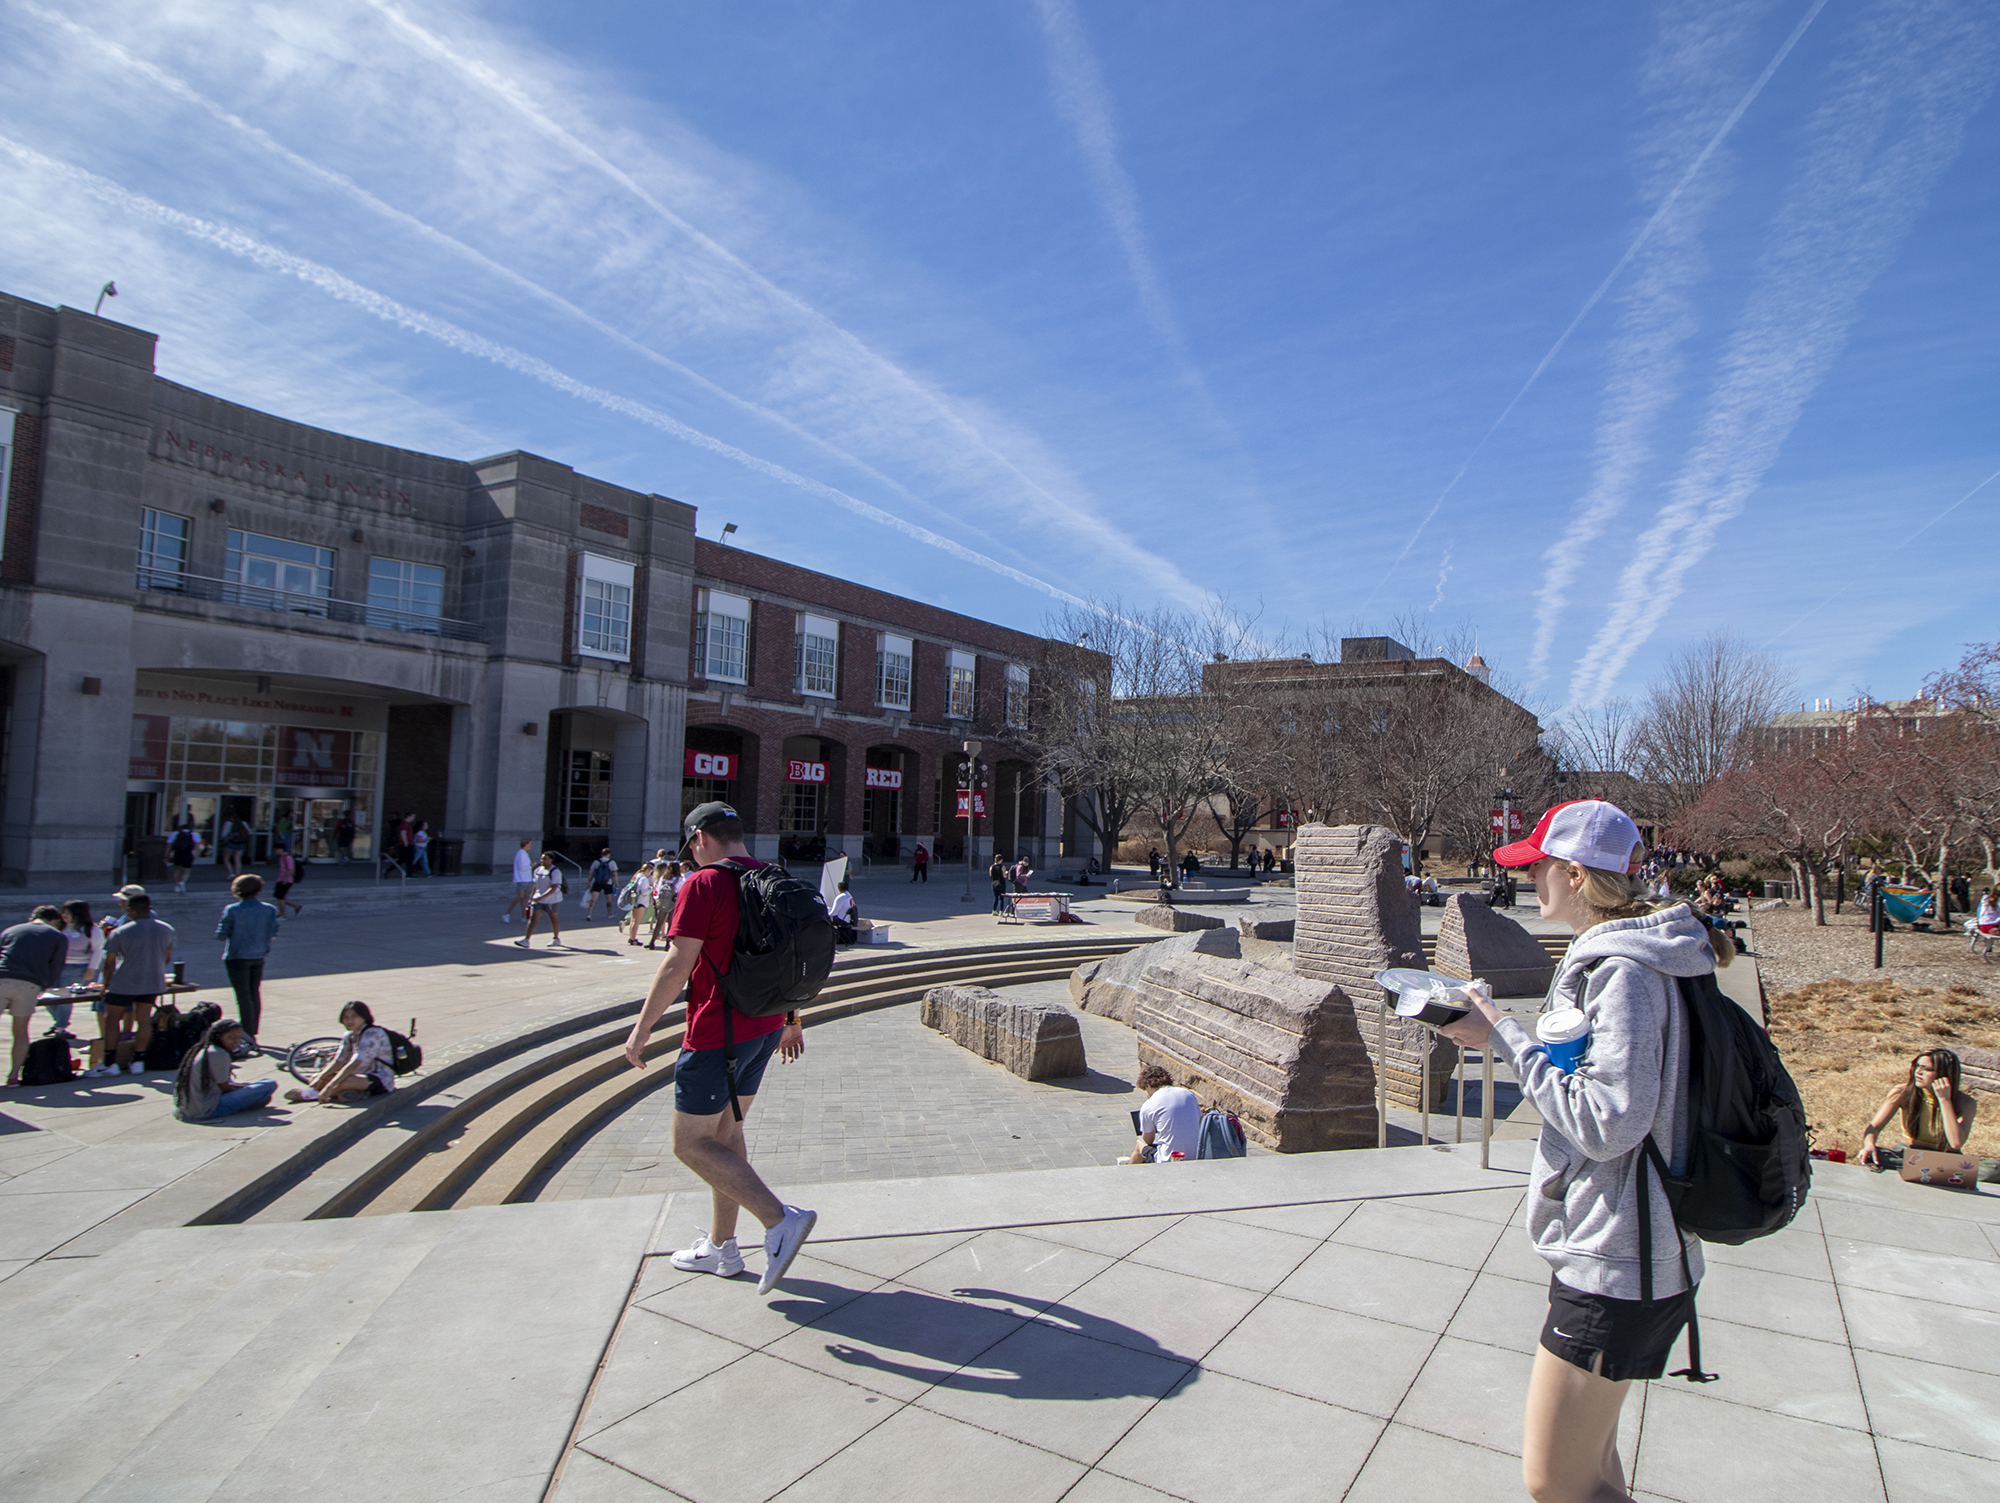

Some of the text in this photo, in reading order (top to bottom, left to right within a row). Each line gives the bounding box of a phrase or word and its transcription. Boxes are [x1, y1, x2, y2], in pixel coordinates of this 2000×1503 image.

[165, 430, 412, 504] NEBRASKA UNION
[293, 731, 335, 768] N
[694, 753, 729, 776] GO
[789, 760, 826, 782] BIG
[866, 768, 902, 788] RED
[958, 797, 969, 809] N
[1493, 816, 1503, 826] N
